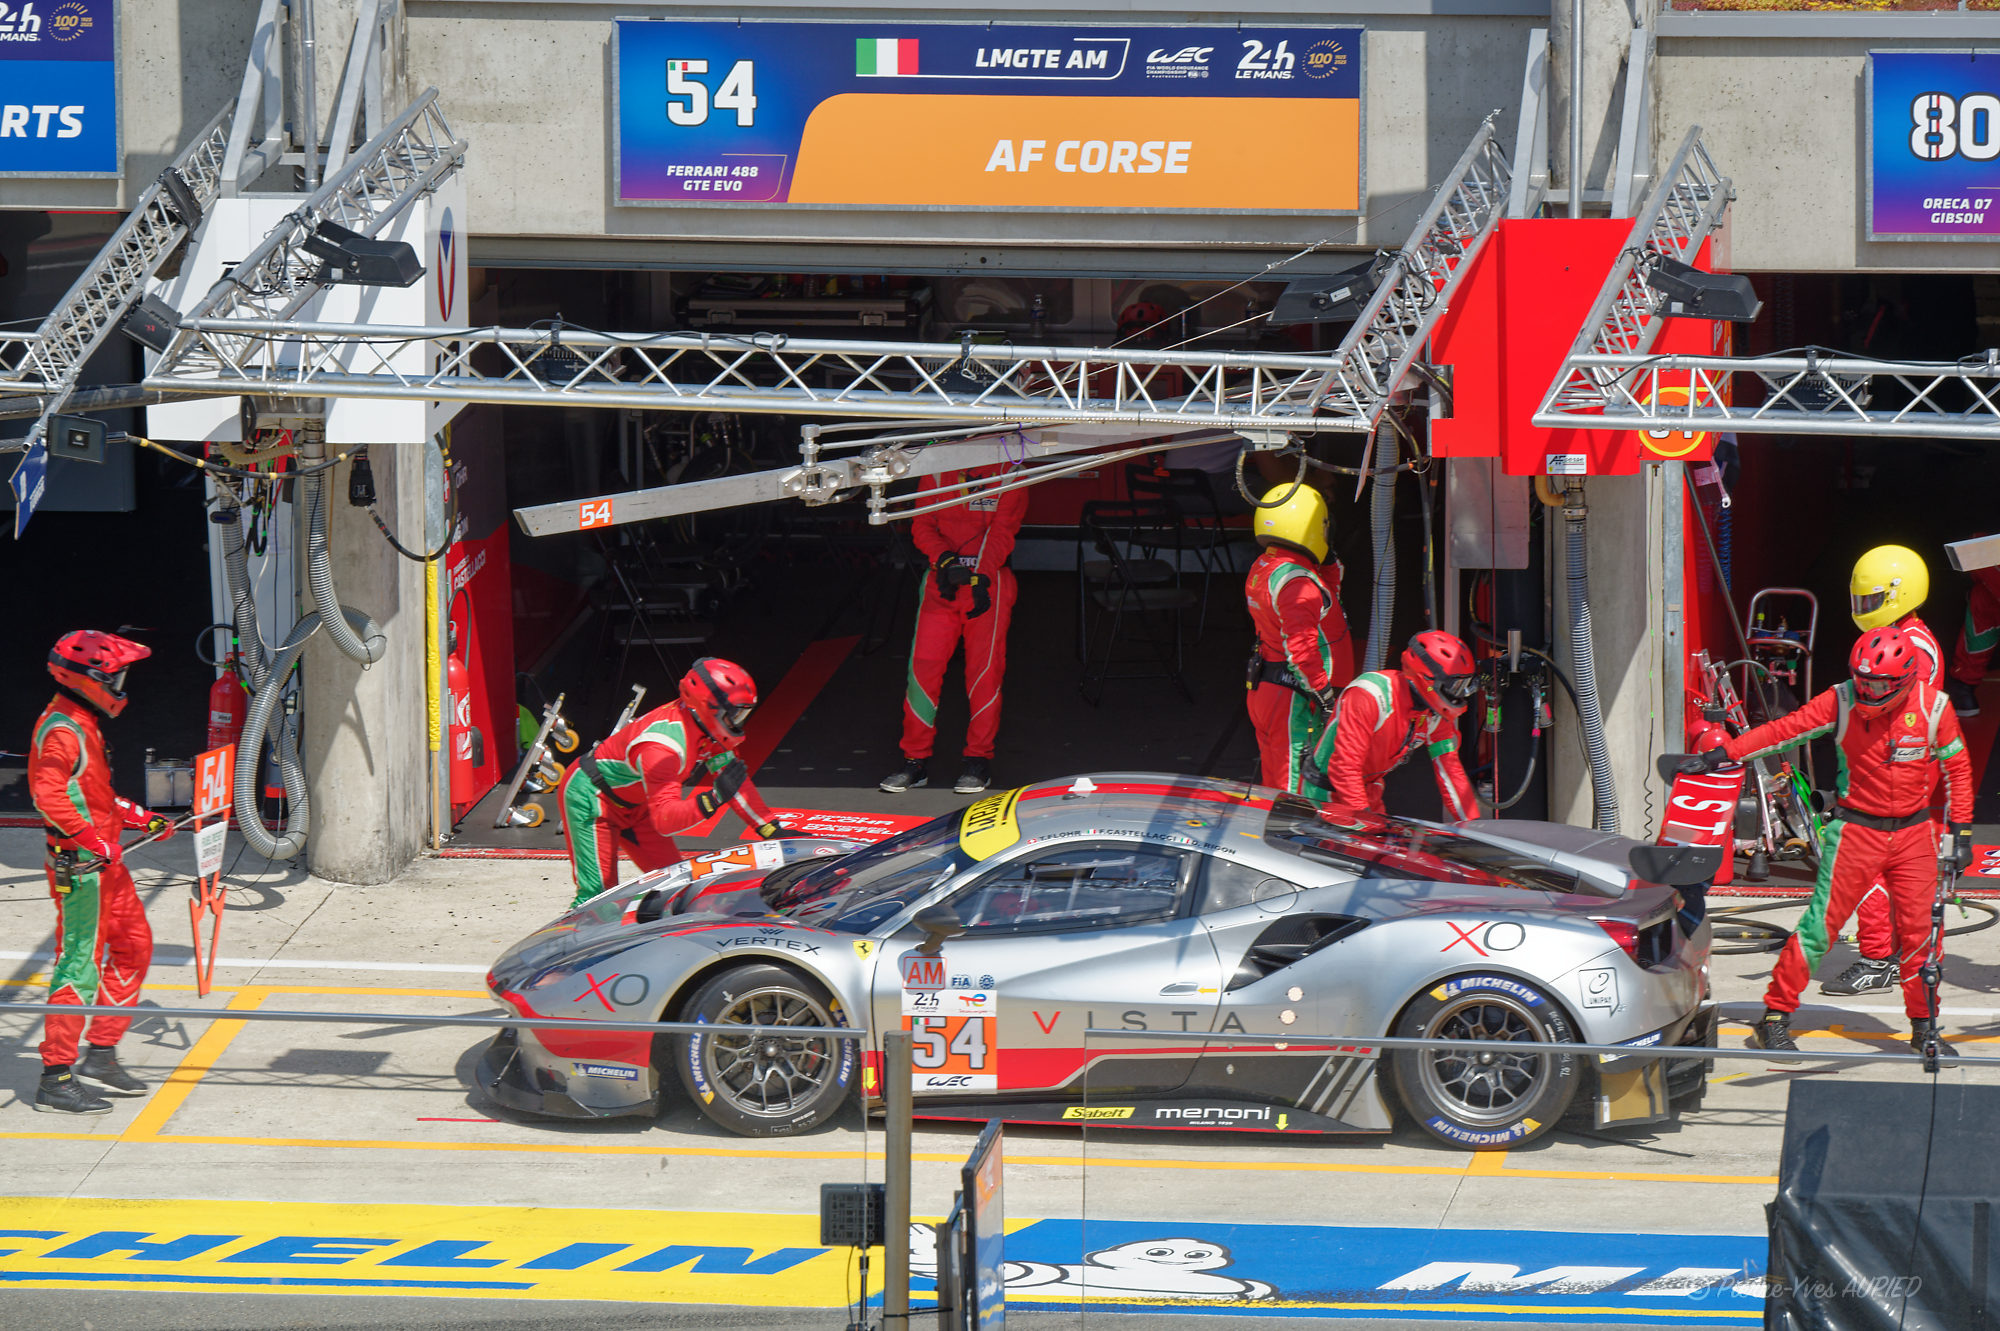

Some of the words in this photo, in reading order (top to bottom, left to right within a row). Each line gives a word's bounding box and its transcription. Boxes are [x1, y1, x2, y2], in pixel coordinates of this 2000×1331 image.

[0, 33, 38, 42] MANS
[975, 48, 1061, 69] LMGTE
[1065, 50, 1108, 69] AM
[1146, 46, 1214, 63] WEC
[1237, 39, 1295, 70] 24h
[1307, 53, 1332, 65] 100
[1235, 70, 1252, 79] LE
[1253, 70, 1292, 79] MANS
[666, 58, 758, 127] 54
[1908, 91, 2000, 162] 80
[984, 139, 1046, 172] AF
[1054, 140, 1193, 174] CORSE
[666, 165, 728, 177] FERRARI
[731, 166, 759, 177] 488
[683, 180, 711, 191] GTE
[713, 180, 743, 191] EVO
[1922, 198, 1970, 209] ORECA
[1974, 198, 1993, 210] 07
[1930, 212, 1985, 224] GIBSON
[581, 501, 611, 527] 54
[201, 751, 227, 813] 54
[1039, 830, 1082, 840] T.FLOHR
[1098, 828, 1177, 842] F.CASTELLACCI
[1203, 842, 1237, 855] RIGON
[716, 936, 822, 956] VERTEX
[1440, 921, 1526, 957] XO
[907, 961, 943, 985] AM
[573, 973, 650, 1012] XO
[1460, 977, 1539, 1005] MICHELIN
[1032, 1010, 1247, 1034] VISTA
[911, 1015, 988, 1070] 54
[587, 1065, 636, 1079] MICHELIN
[926, 1075, 973, 1087] WEC
[1071, 1106, 1126, 1119] Sabelt
[1155, 1106, 1271, 1121] menoni
[1433, 1119, 1511, 1145] MICHELIN
